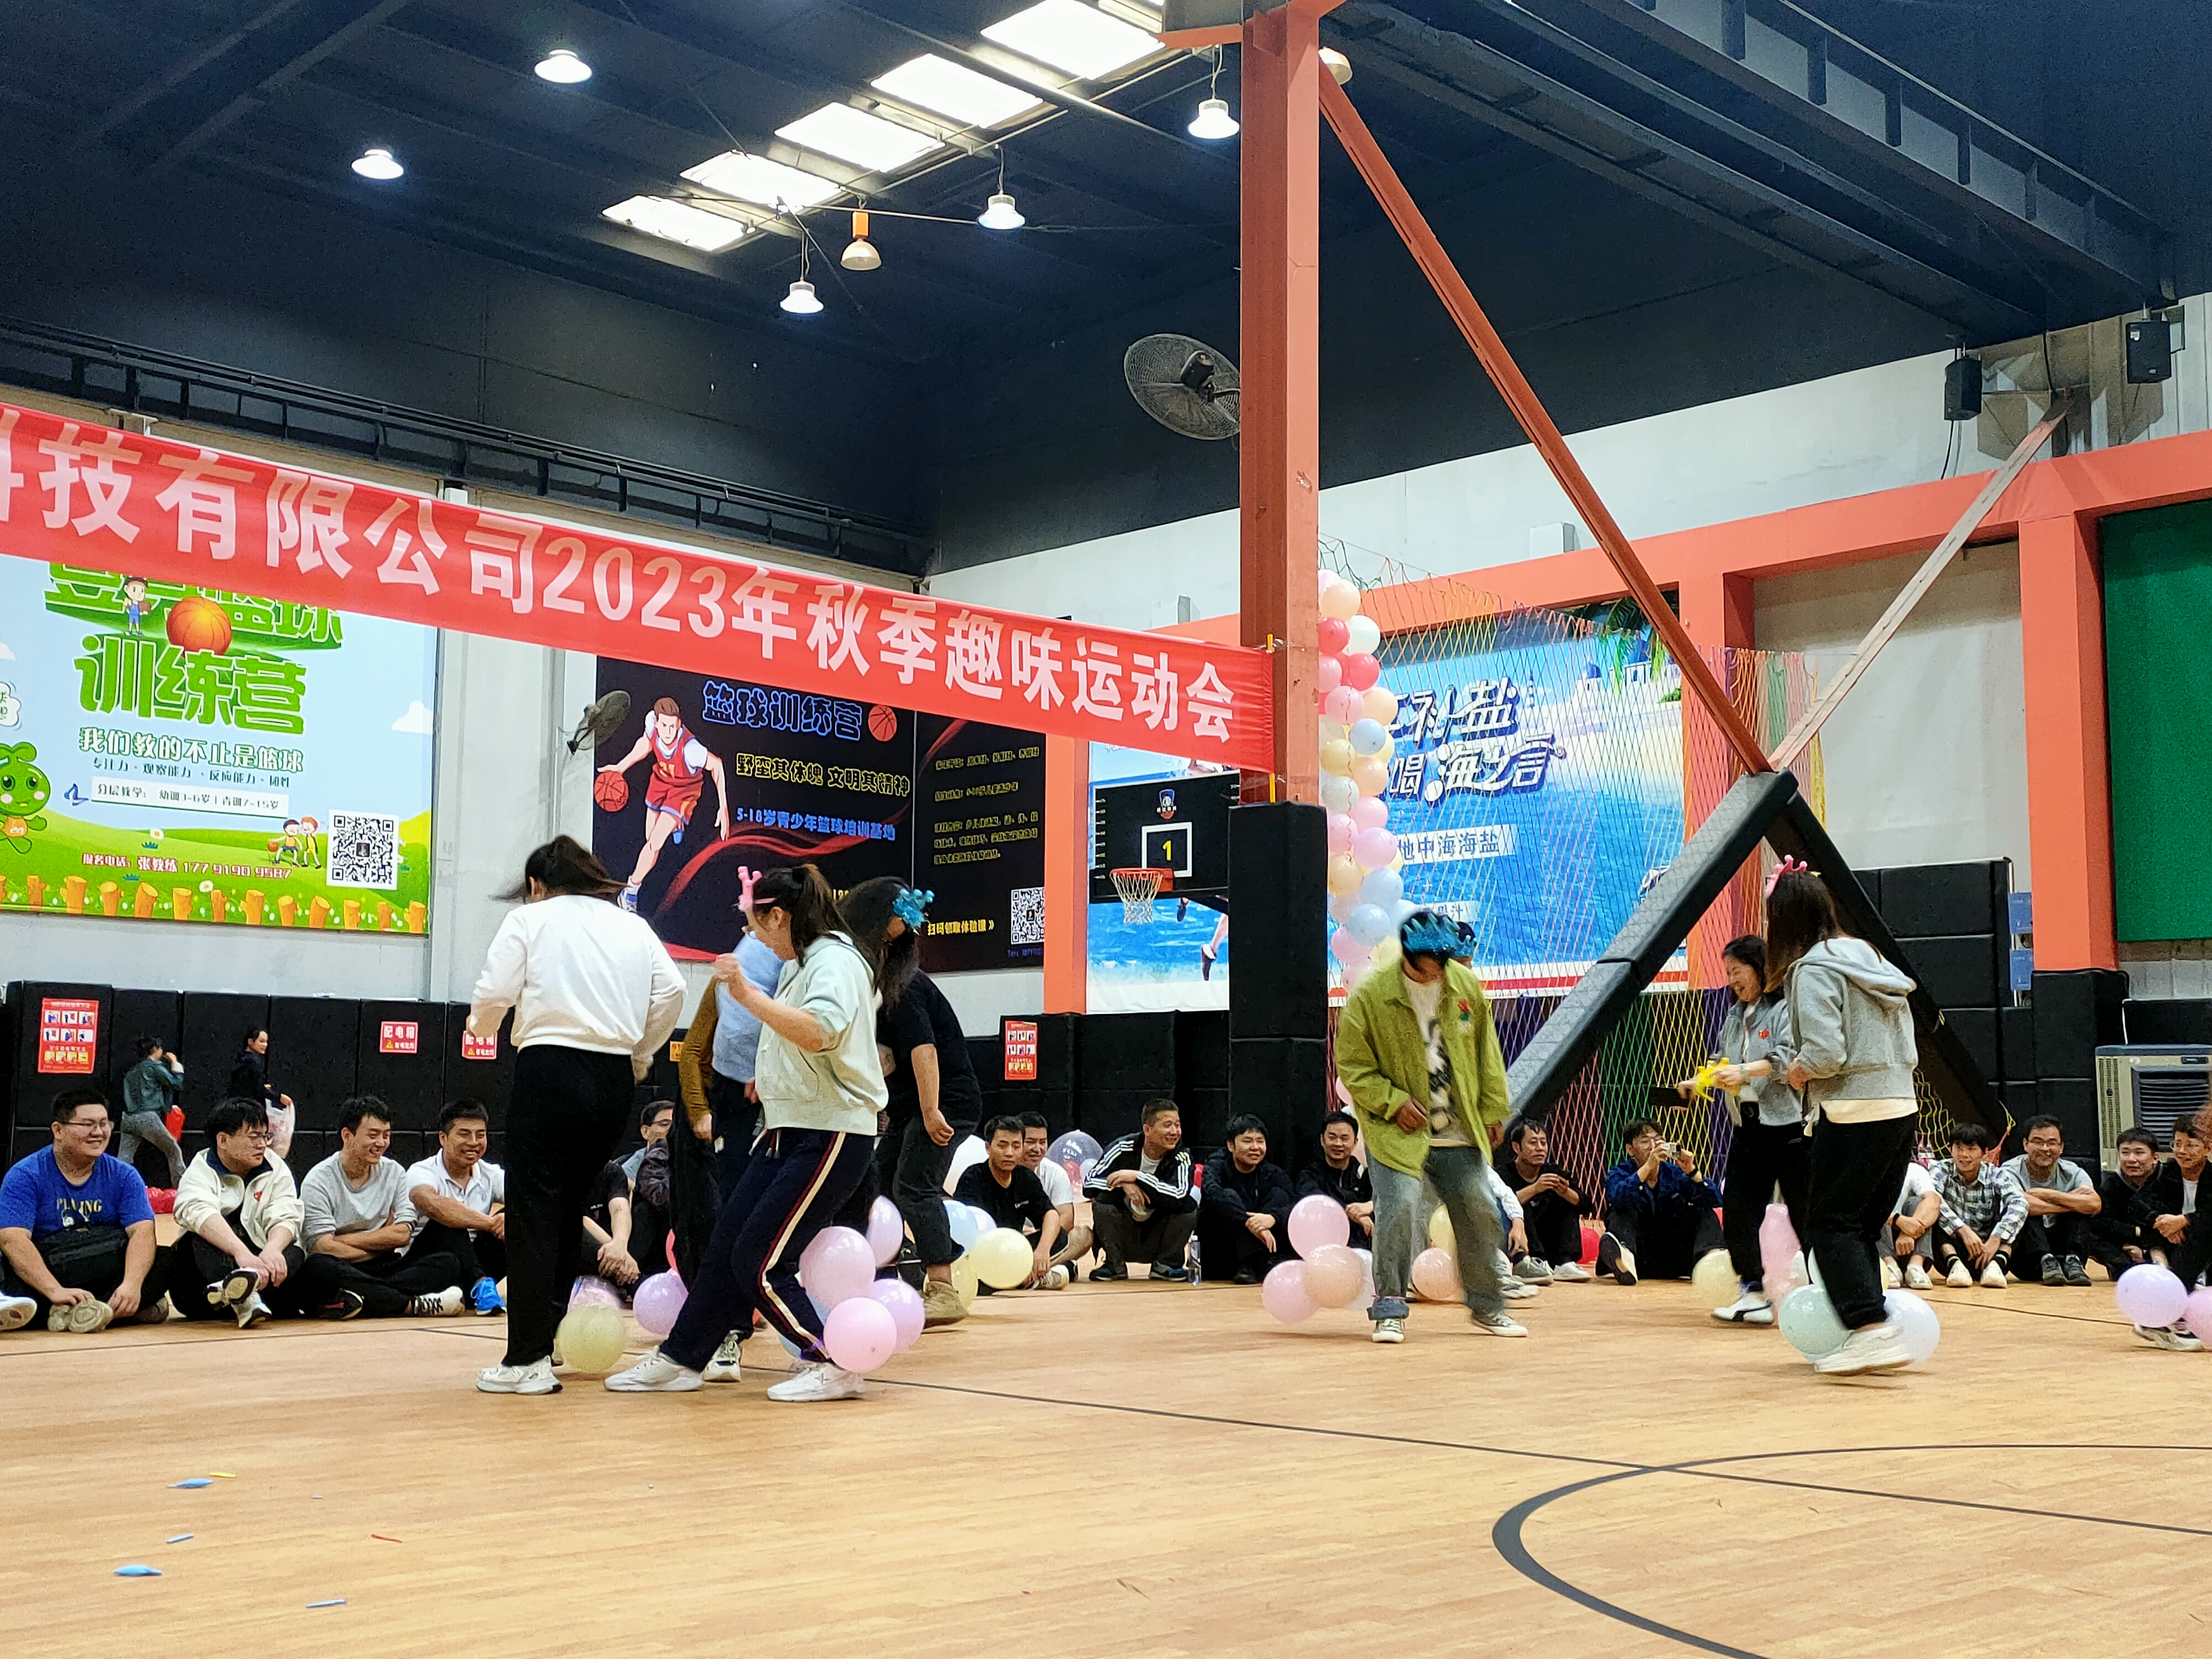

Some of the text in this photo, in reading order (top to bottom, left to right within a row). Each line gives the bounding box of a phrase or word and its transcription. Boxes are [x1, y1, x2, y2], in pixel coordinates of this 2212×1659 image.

[0, 409, 1234, 743] 技有限公司2023年秋季趣味运动会
[74, 634, 306, 734] 训练营
[702, 680, 862, 741] 篮球训练营
[79, 727, 304, 773] 我们教的不止是篮球
[736, 753, 823, 786] 野蛮其体魄
[828, 766, 910, 797] 文明其精神
[1162, 840, 1172, 861] 1
[1397, 830, 1500, 860] 地中海海盐
[183, 861, 210, 874] 177
[383, 1025, 415, 1039] 配电箱
